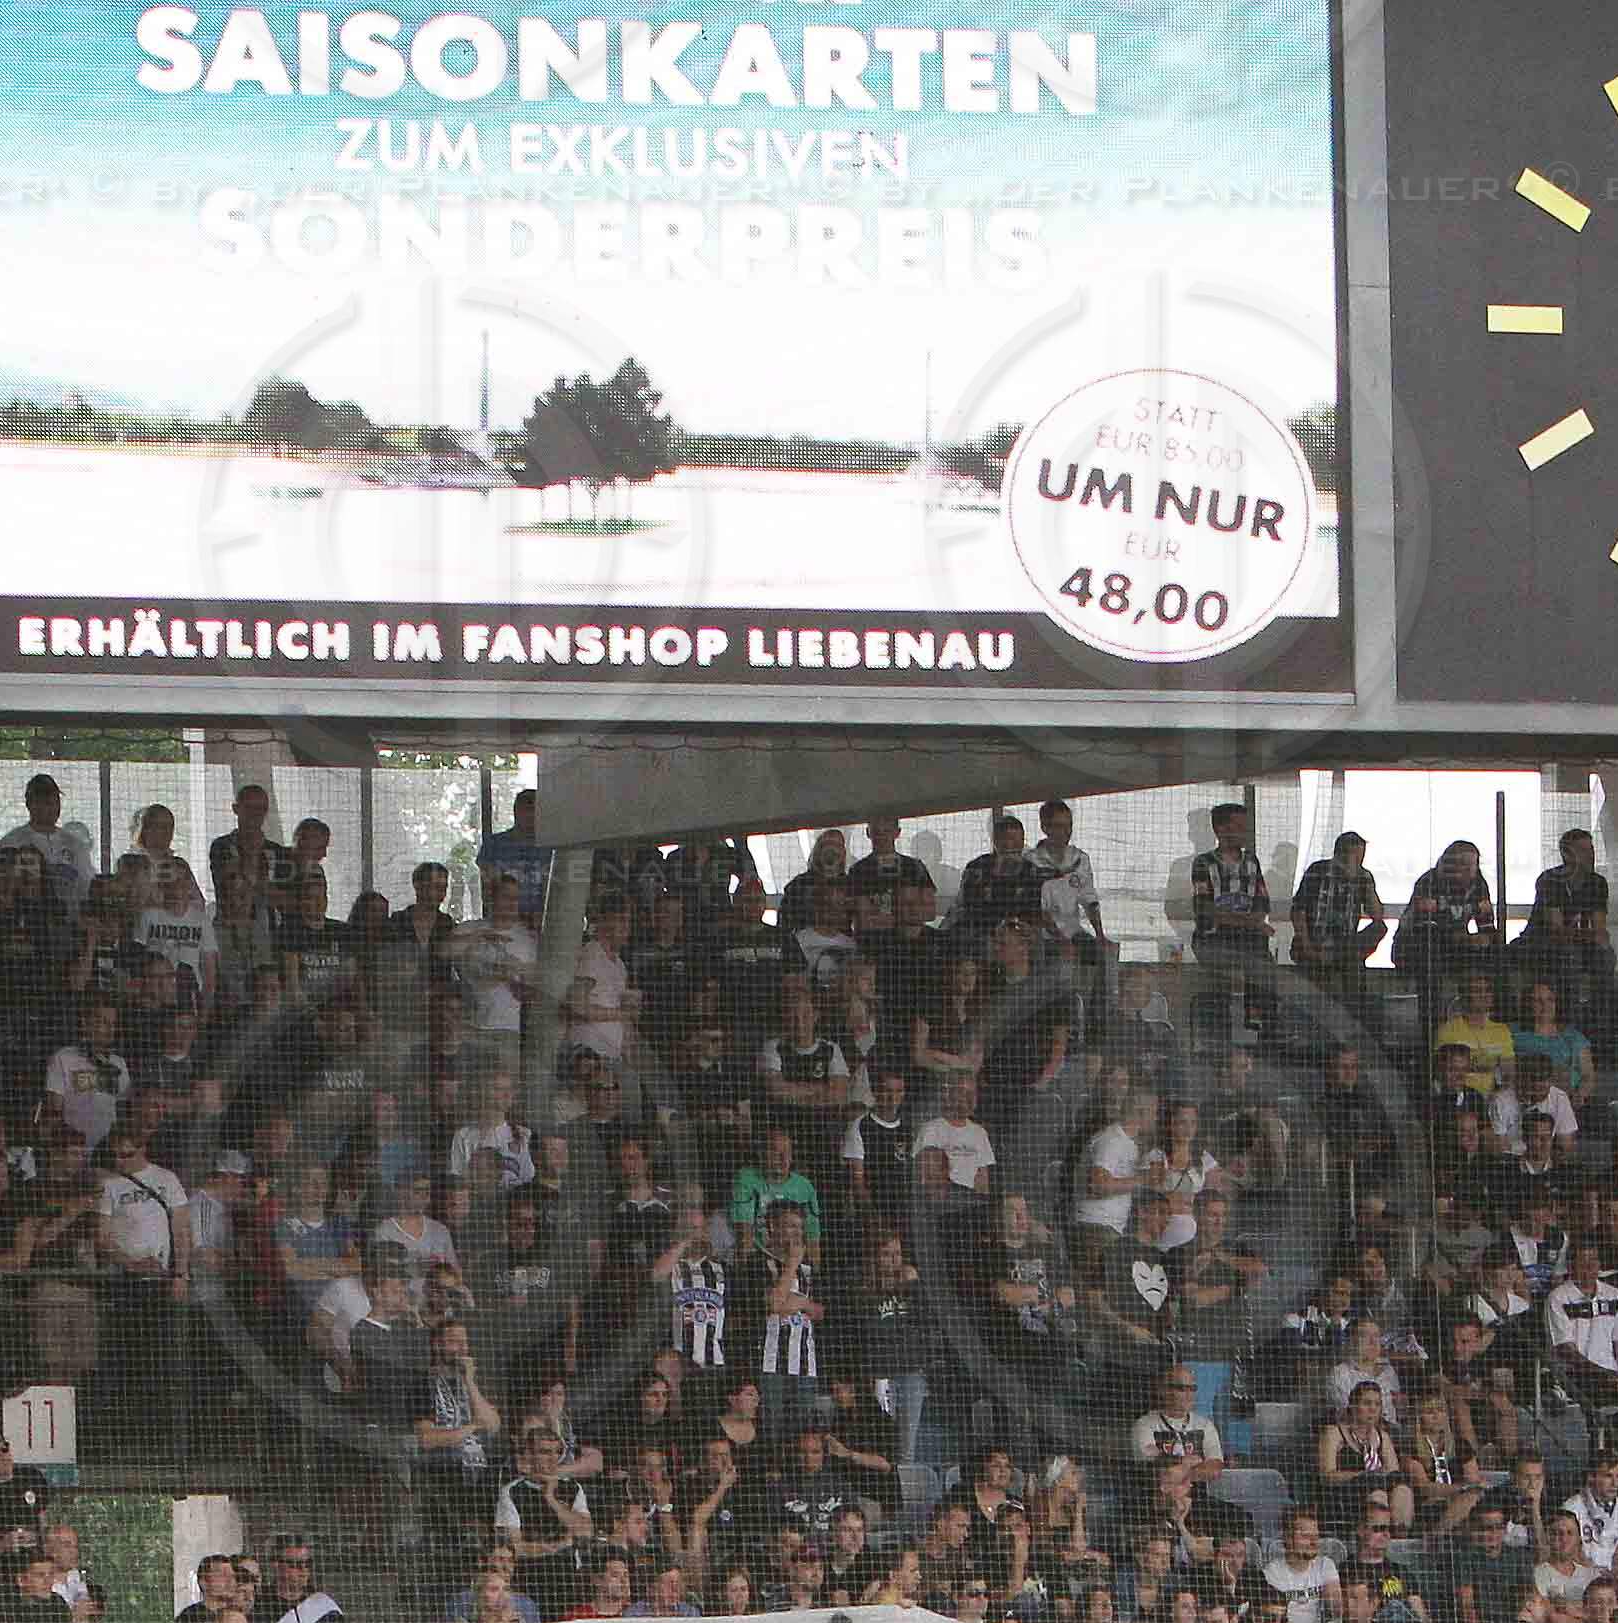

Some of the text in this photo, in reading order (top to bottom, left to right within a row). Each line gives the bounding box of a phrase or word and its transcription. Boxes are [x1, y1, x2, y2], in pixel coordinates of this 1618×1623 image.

[134, 4, 1097, 115] SAISONKARTEN
[335, 116, 910, 182] ZUM EXKLUSIVEN
[196, 186, 1050, 292] SONDERPREIS
[1037, 457, 1285, 541] UM NUR
[1059, 566, 1229, 631] 48,00
[17, 607, 1016, 672] ERHÄLTLICH IM FANSHOP LIEBENAU
